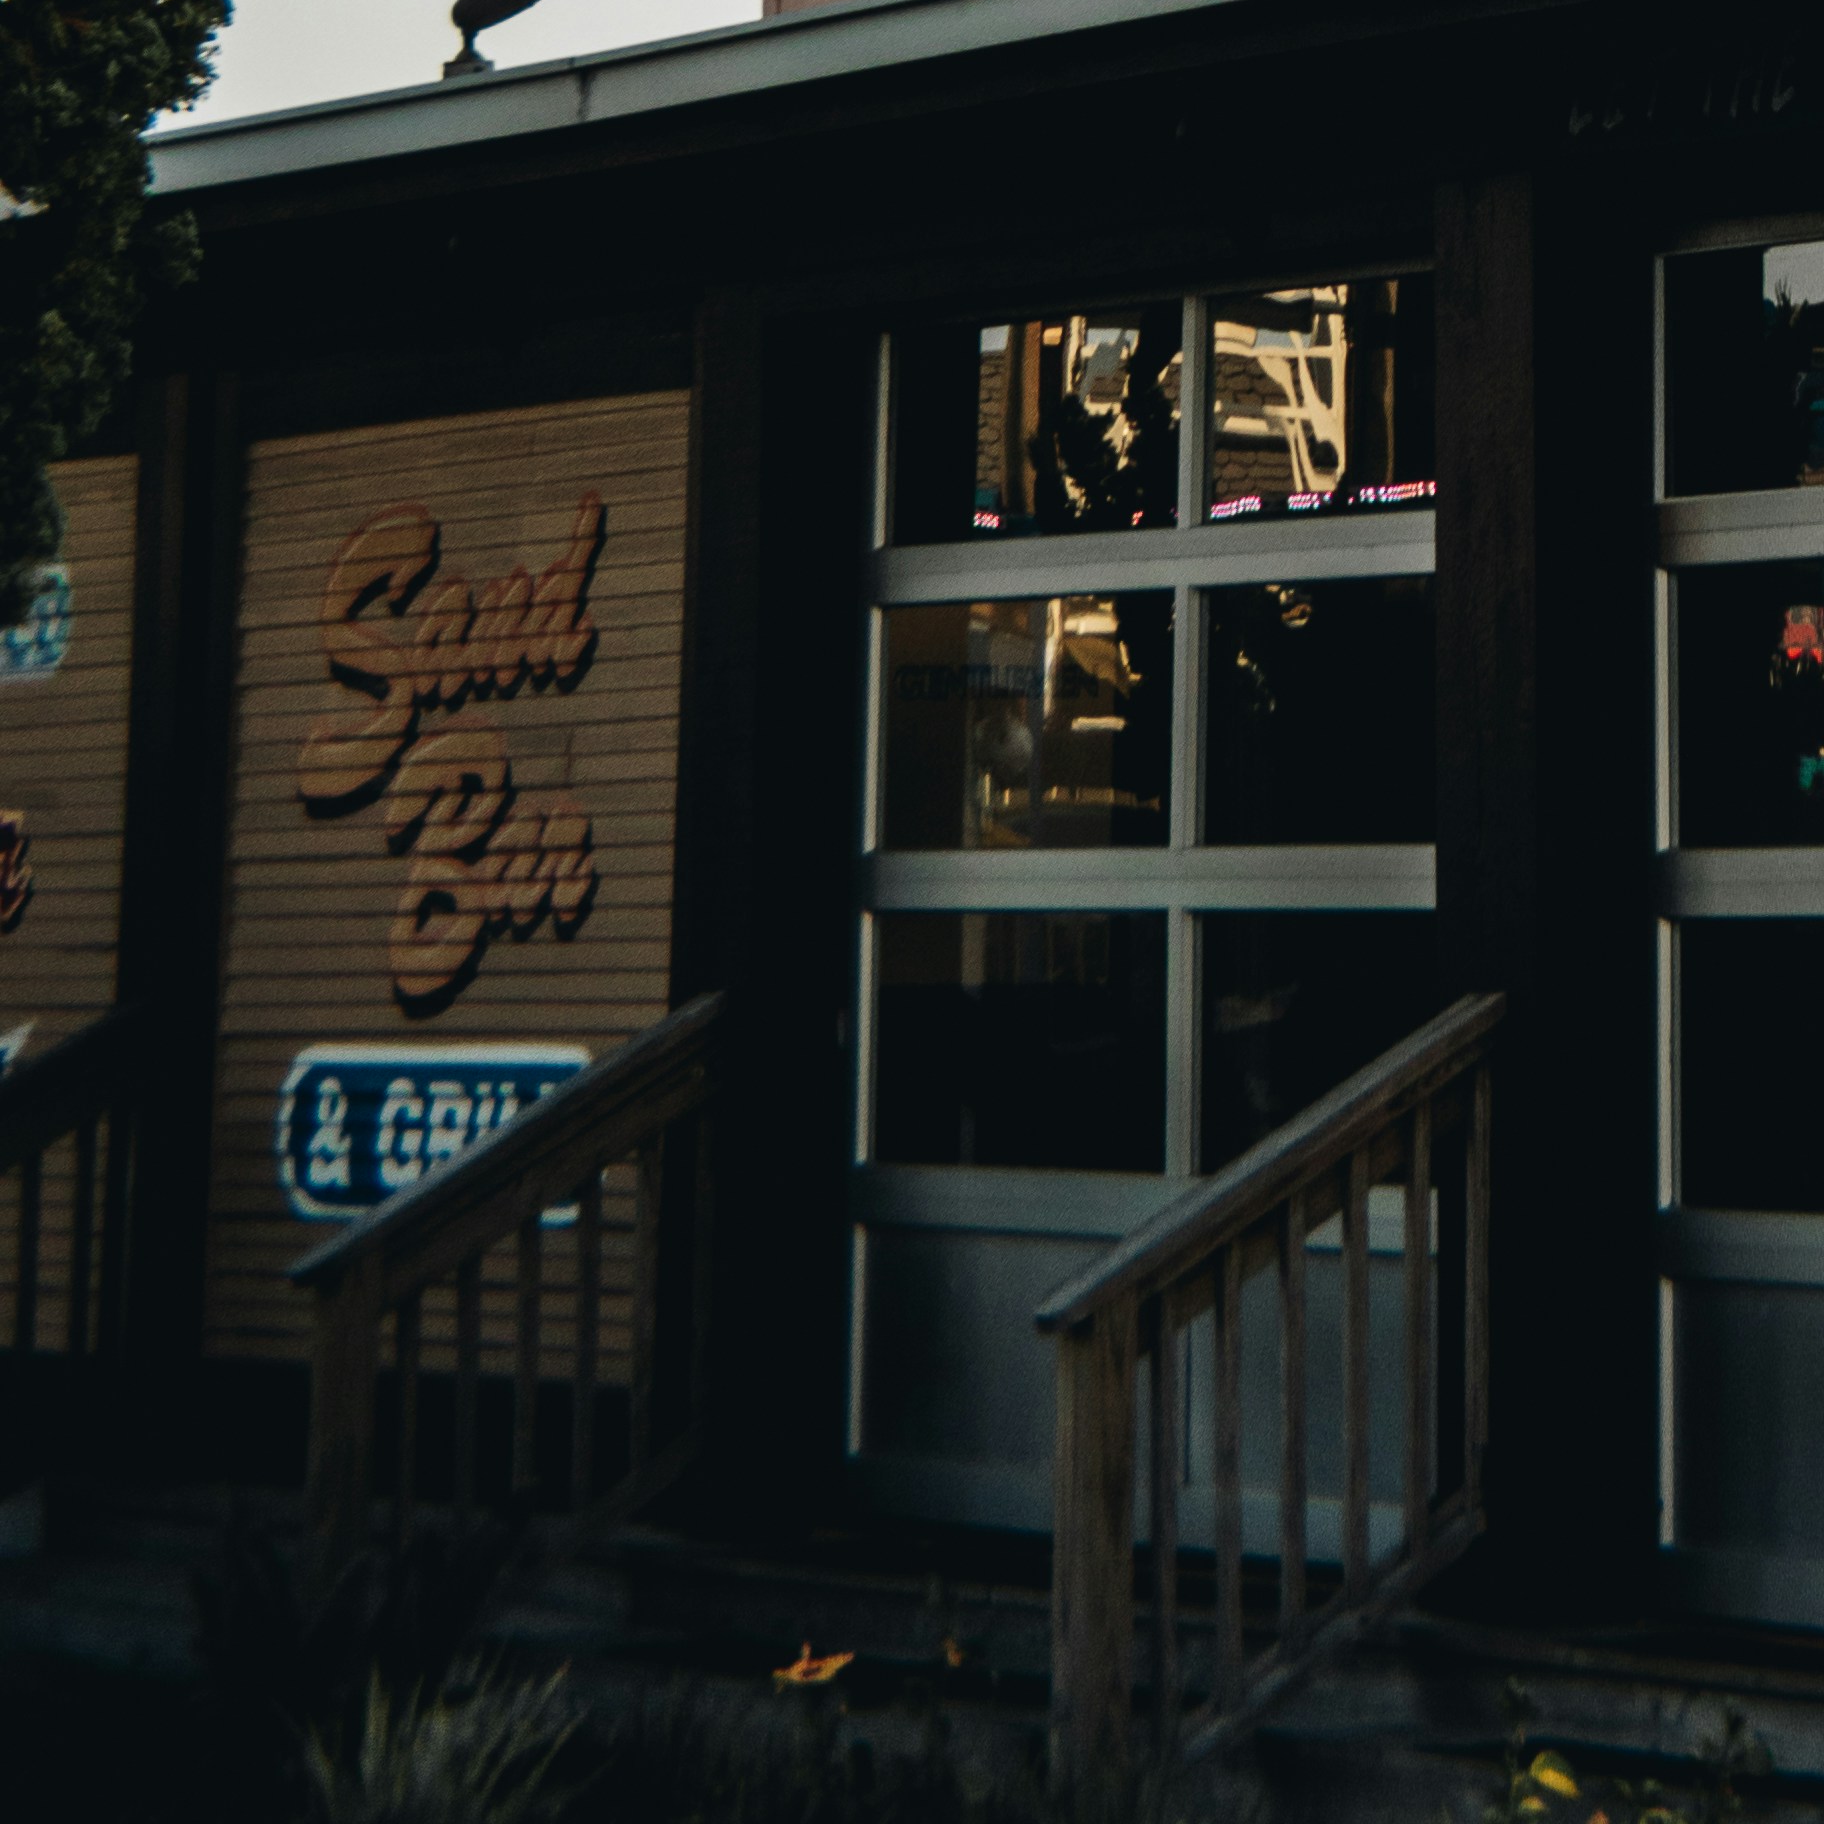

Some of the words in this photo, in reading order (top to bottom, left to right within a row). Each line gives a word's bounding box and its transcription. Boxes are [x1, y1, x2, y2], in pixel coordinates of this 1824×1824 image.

[298, 490, 606, 819] Sand
[306, 1075, 352, 1189] &
[375, 1075, 557, 1190] GRI
